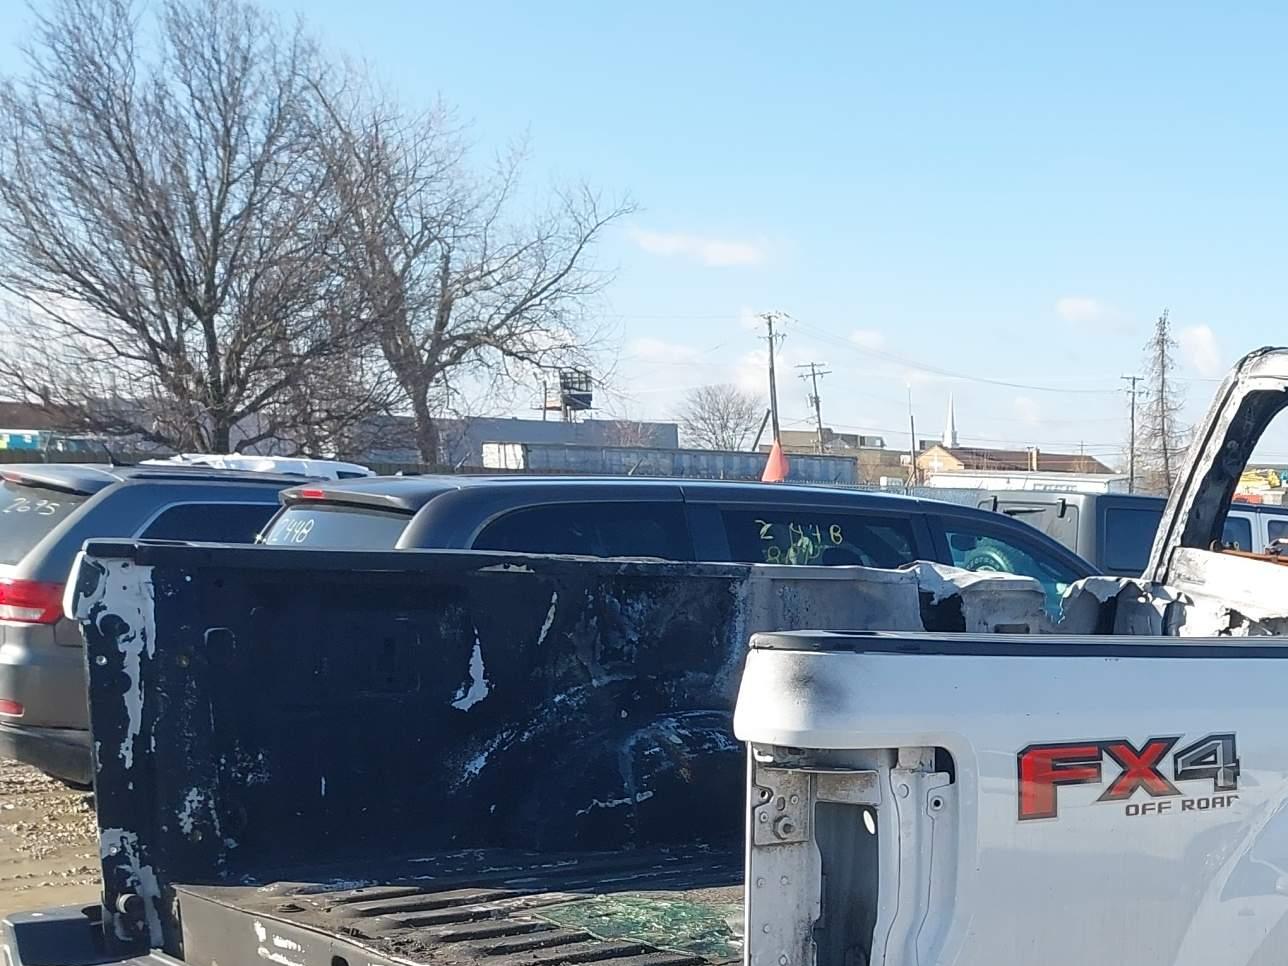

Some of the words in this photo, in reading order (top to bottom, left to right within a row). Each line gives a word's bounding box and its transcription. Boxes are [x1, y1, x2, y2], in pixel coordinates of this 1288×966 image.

[272, 518, 315, 543] 2448
[1016, 732, 1241, 822] FX4
[1125, 801, 1172, 817] OFF
